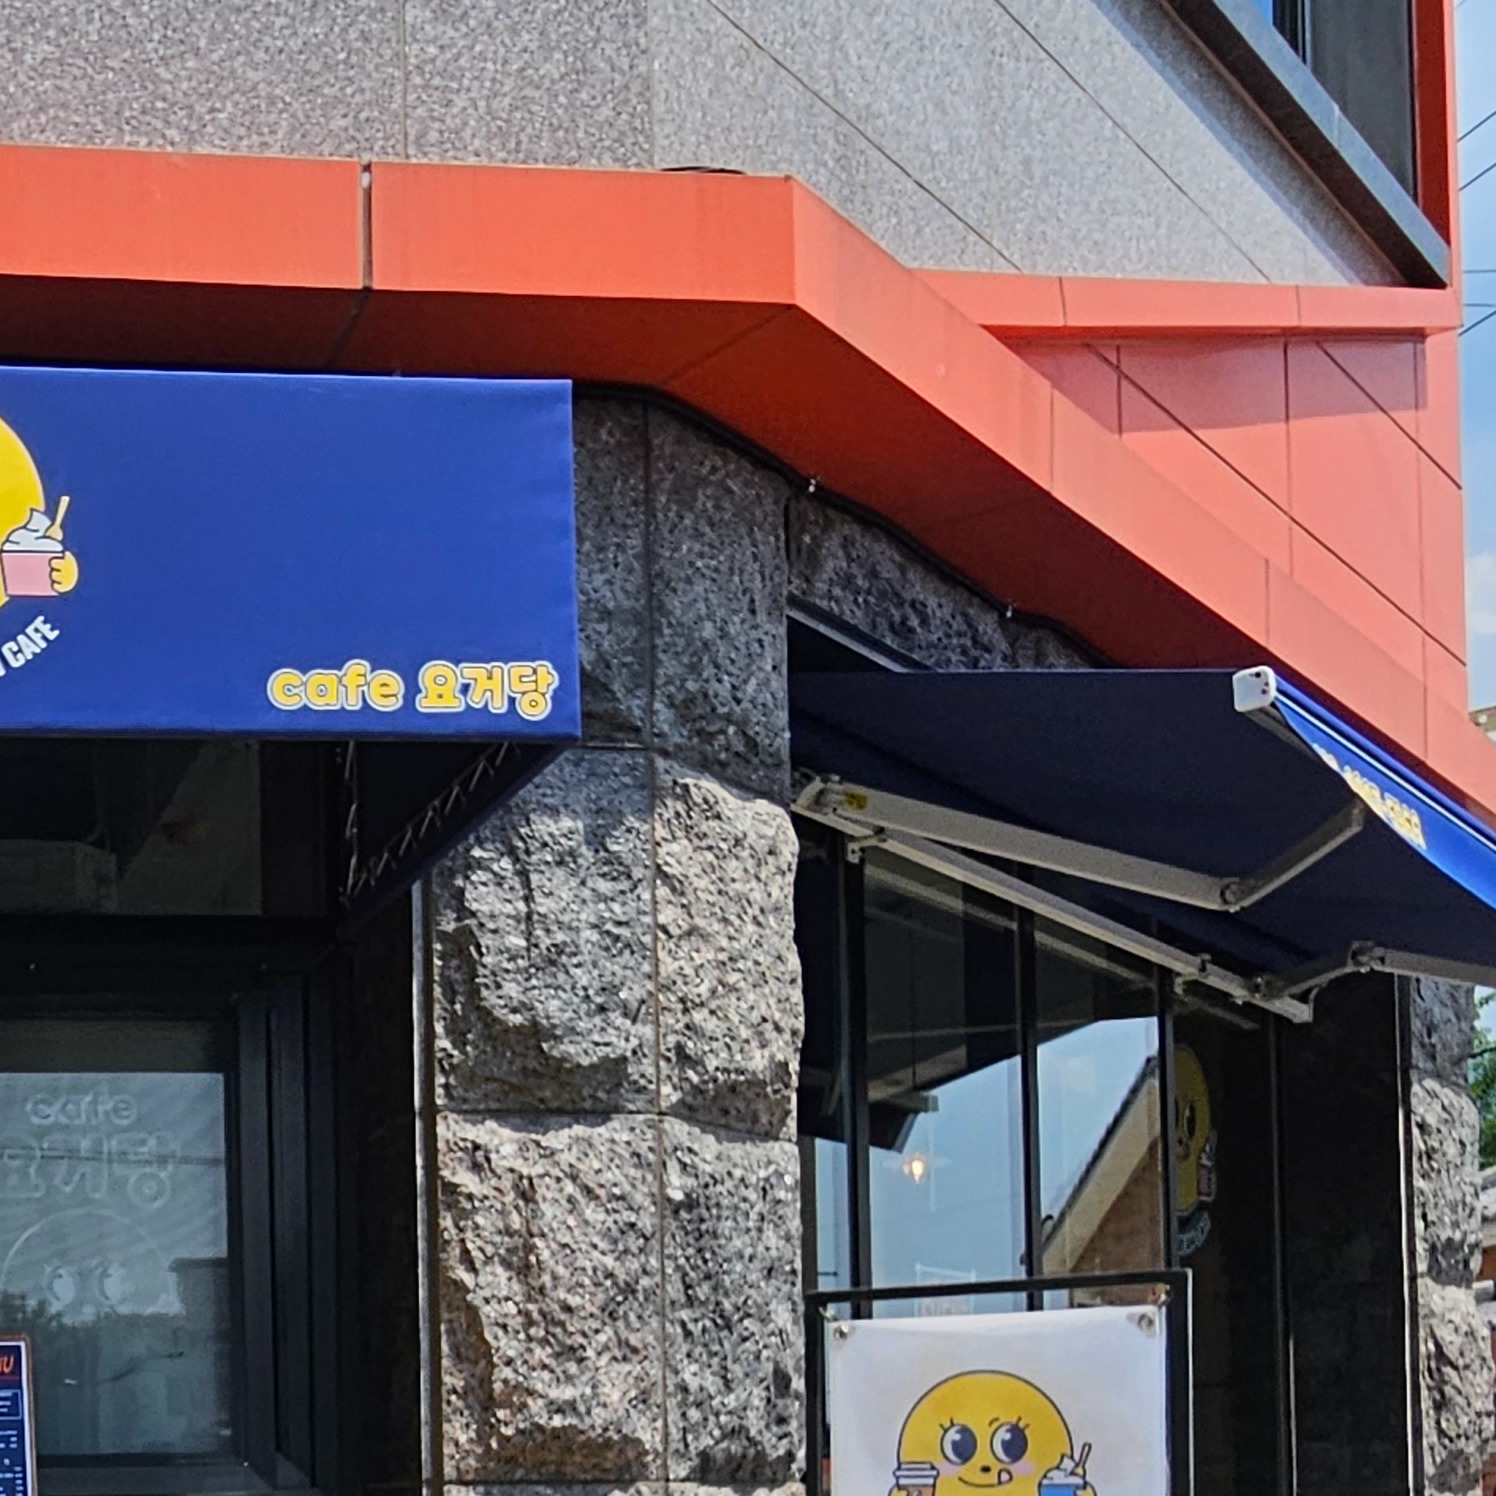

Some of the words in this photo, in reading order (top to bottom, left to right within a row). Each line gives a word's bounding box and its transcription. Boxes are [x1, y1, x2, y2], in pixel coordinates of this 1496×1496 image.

[1, 616, 60, 668] CAFE
[267, 659, 404, 711] cafe
[415, 660, 559, 720] 요거당
